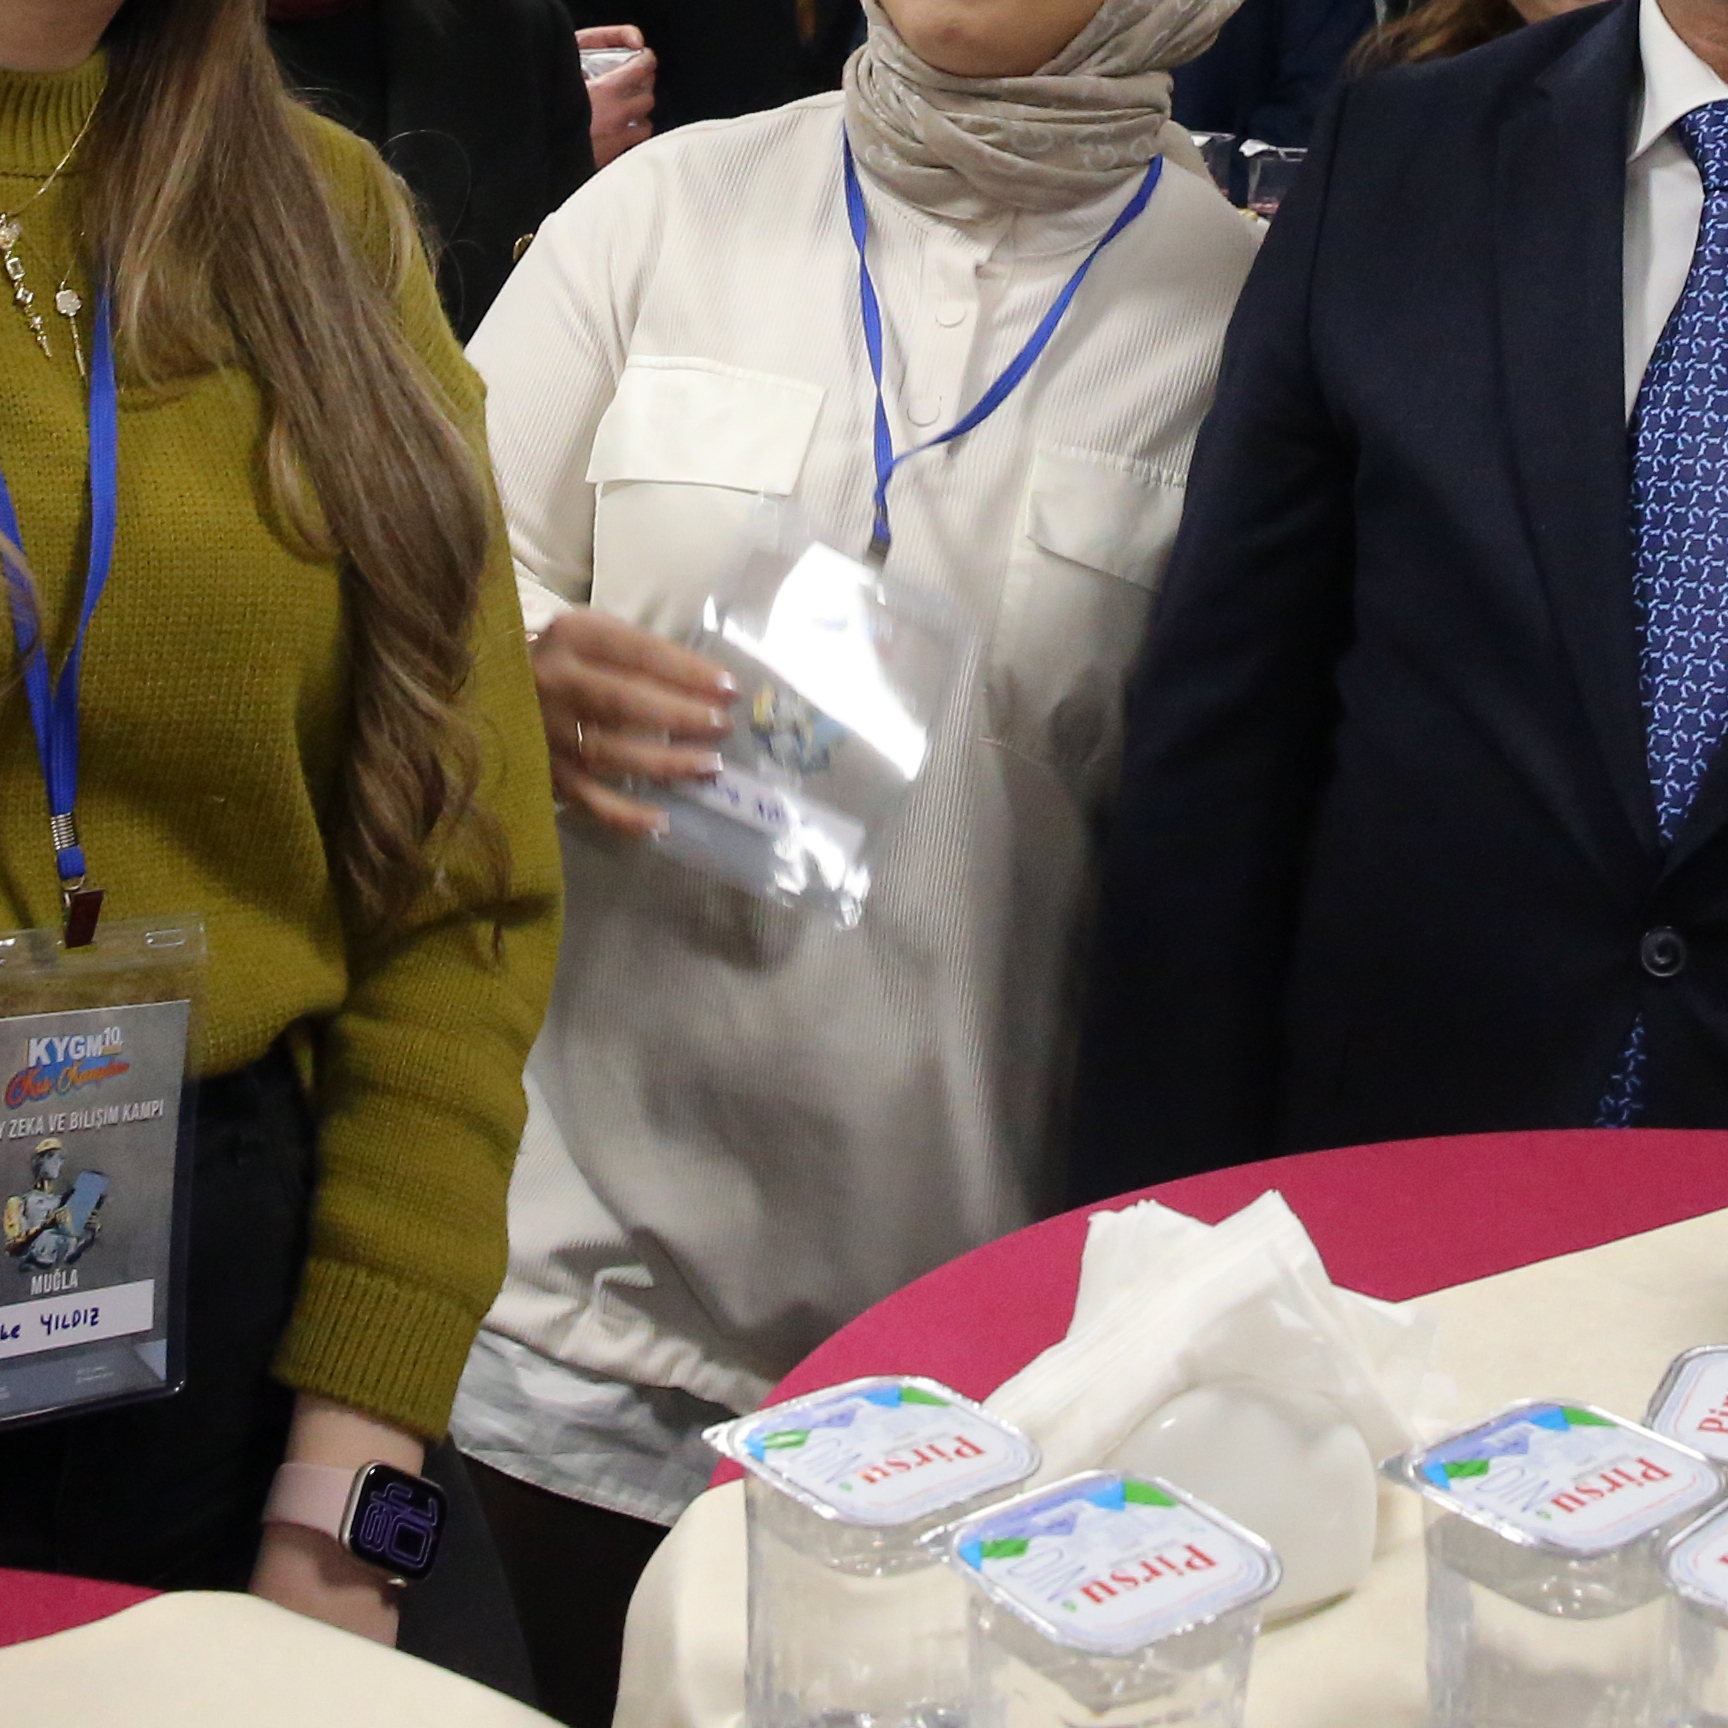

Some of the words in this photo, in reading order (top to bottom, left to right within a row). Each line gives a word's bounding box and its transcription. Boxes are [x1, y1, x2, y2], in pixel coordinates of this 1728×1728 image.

[28, 1033, 102, 1068] KYGM
[8, 1116, 44, 1139] ZEKA
[48, 1112, 67, 1133] VE
[122, 1099, 164, 1122] KAMPI
[30, 1268, 79, 1296] MUĞLA
[40, 1307, 100, 1335] YILDIZ
[858, 1435, 986, 1486] Pirsu
[1550, 1458, 1672, 1516] Pirsu
[1079, 1543, 1218, 1607] Pirsu
